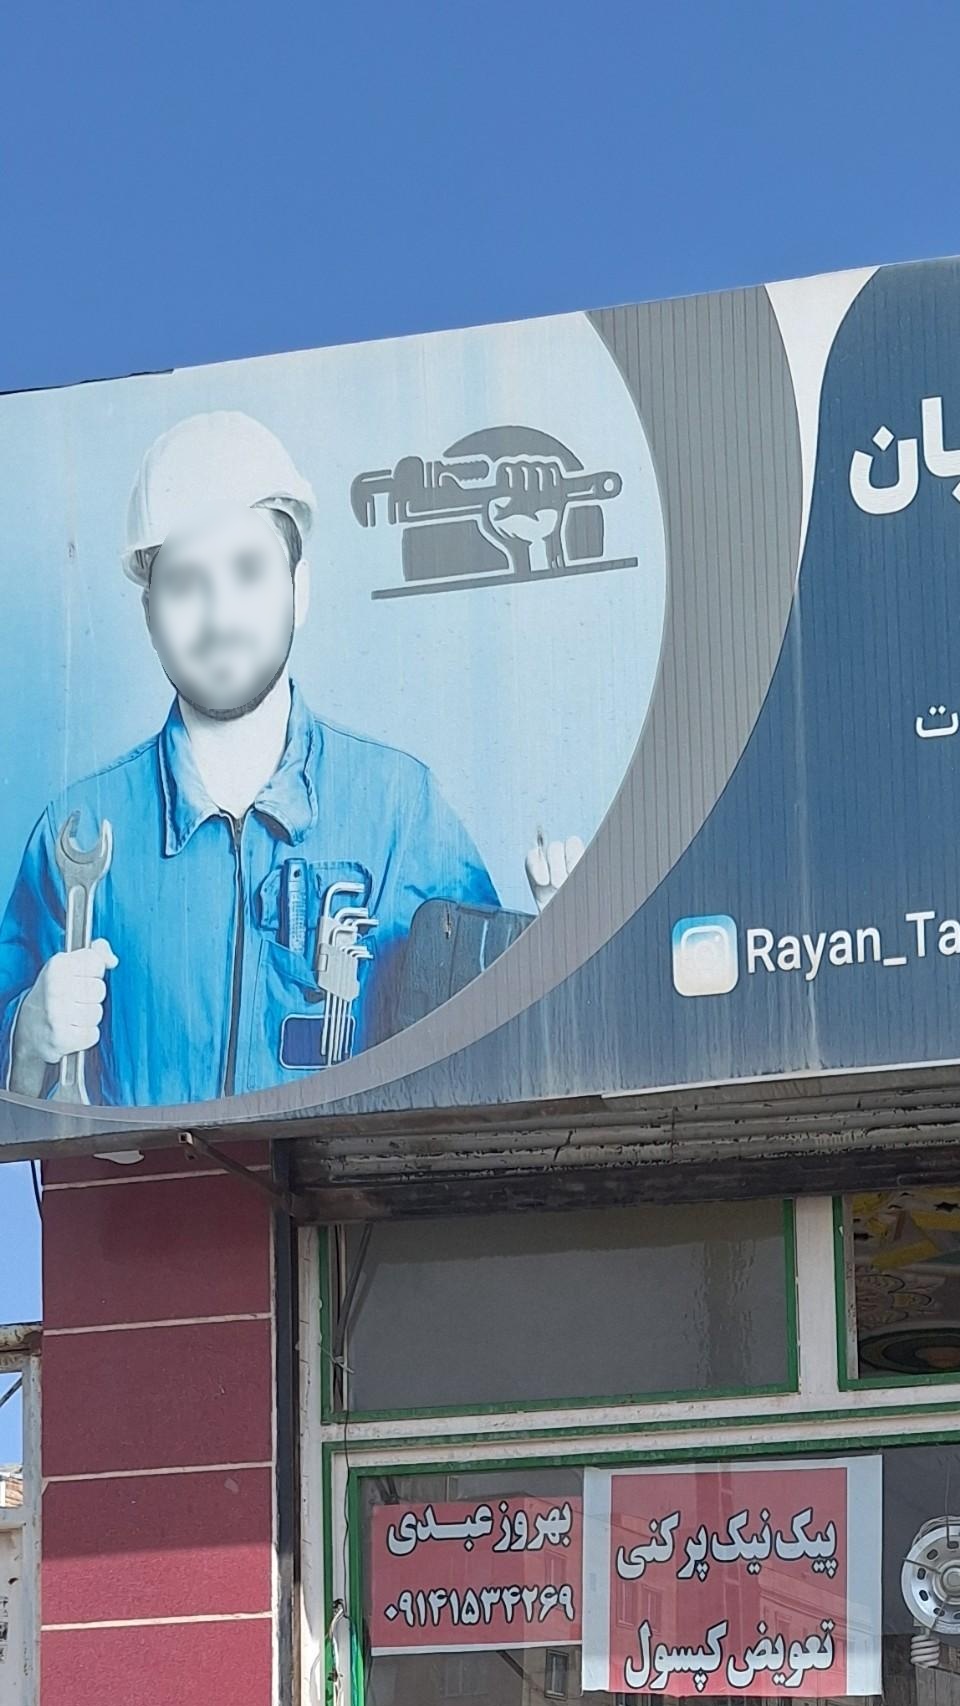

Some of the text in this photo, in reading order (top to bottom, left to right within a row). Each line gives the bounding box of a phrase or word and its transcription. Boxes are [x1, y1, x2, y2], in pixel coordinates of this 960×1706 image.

[387, 1500, 573, 1556] بهروز عبدی
[384, 1583, 576, 1628] ۰۹۱۴۱۵۳۴۲۶۹
[624, 1618, 837, 1692] تعویض کپسول
